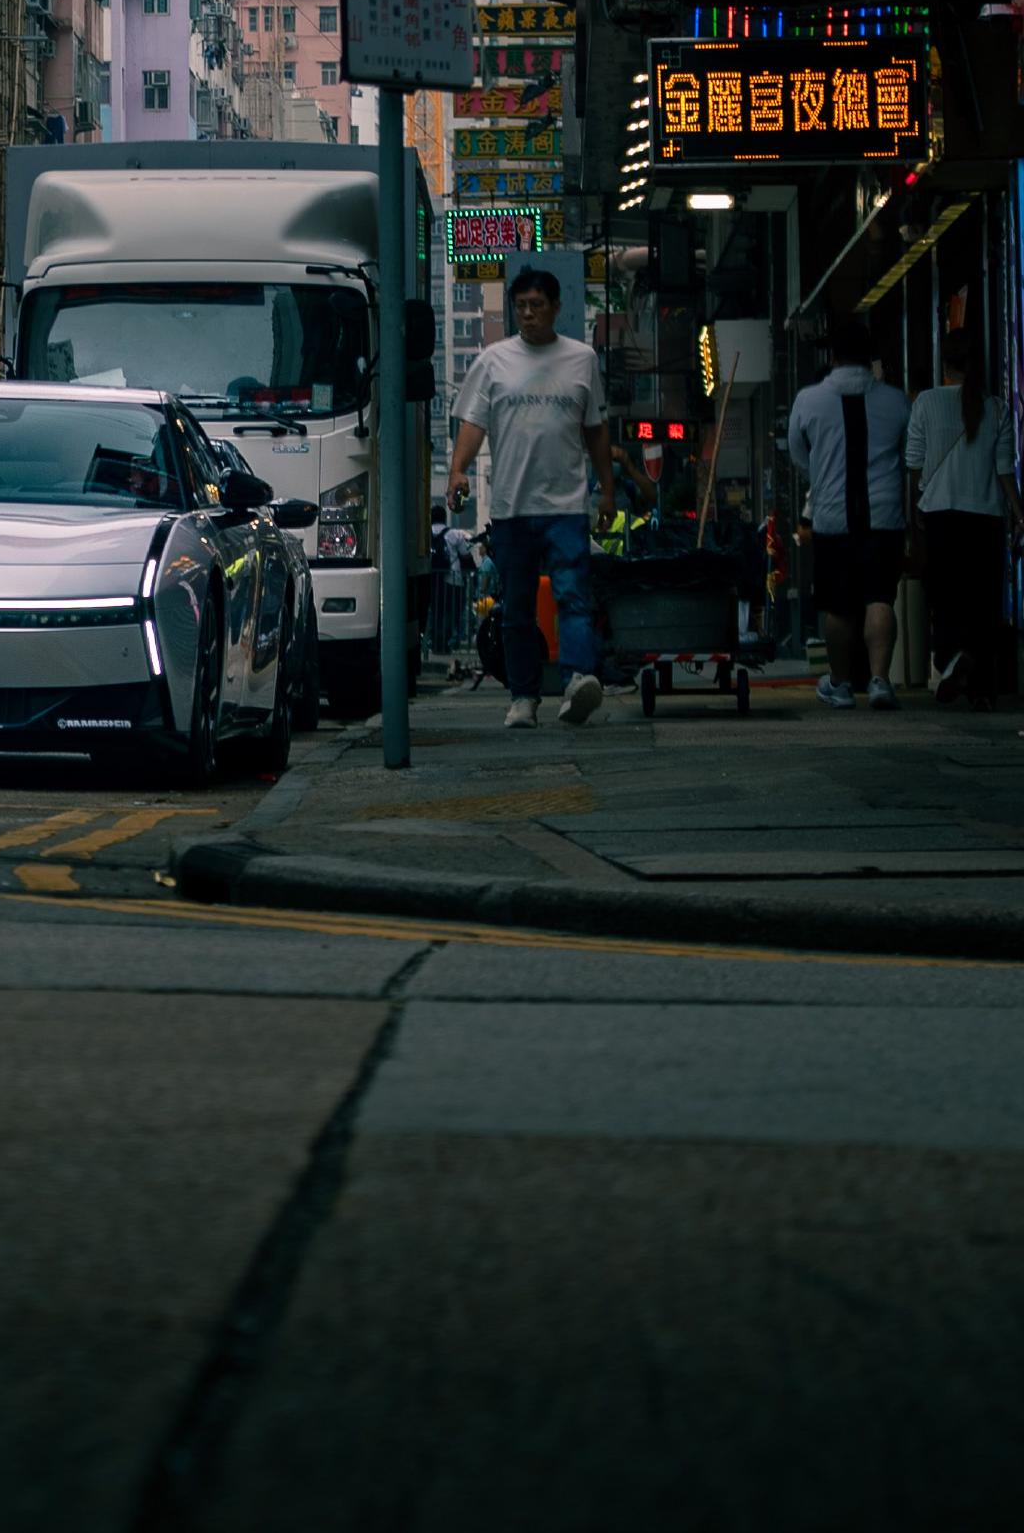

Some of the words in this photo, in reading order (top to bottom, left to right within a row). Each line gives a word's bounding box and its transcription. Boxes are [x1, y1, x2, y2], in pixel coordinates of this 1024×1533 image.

[664, 67, 910, 133] 金麗宮夜總會
[454, 215, 517, 247] 知足常樂
